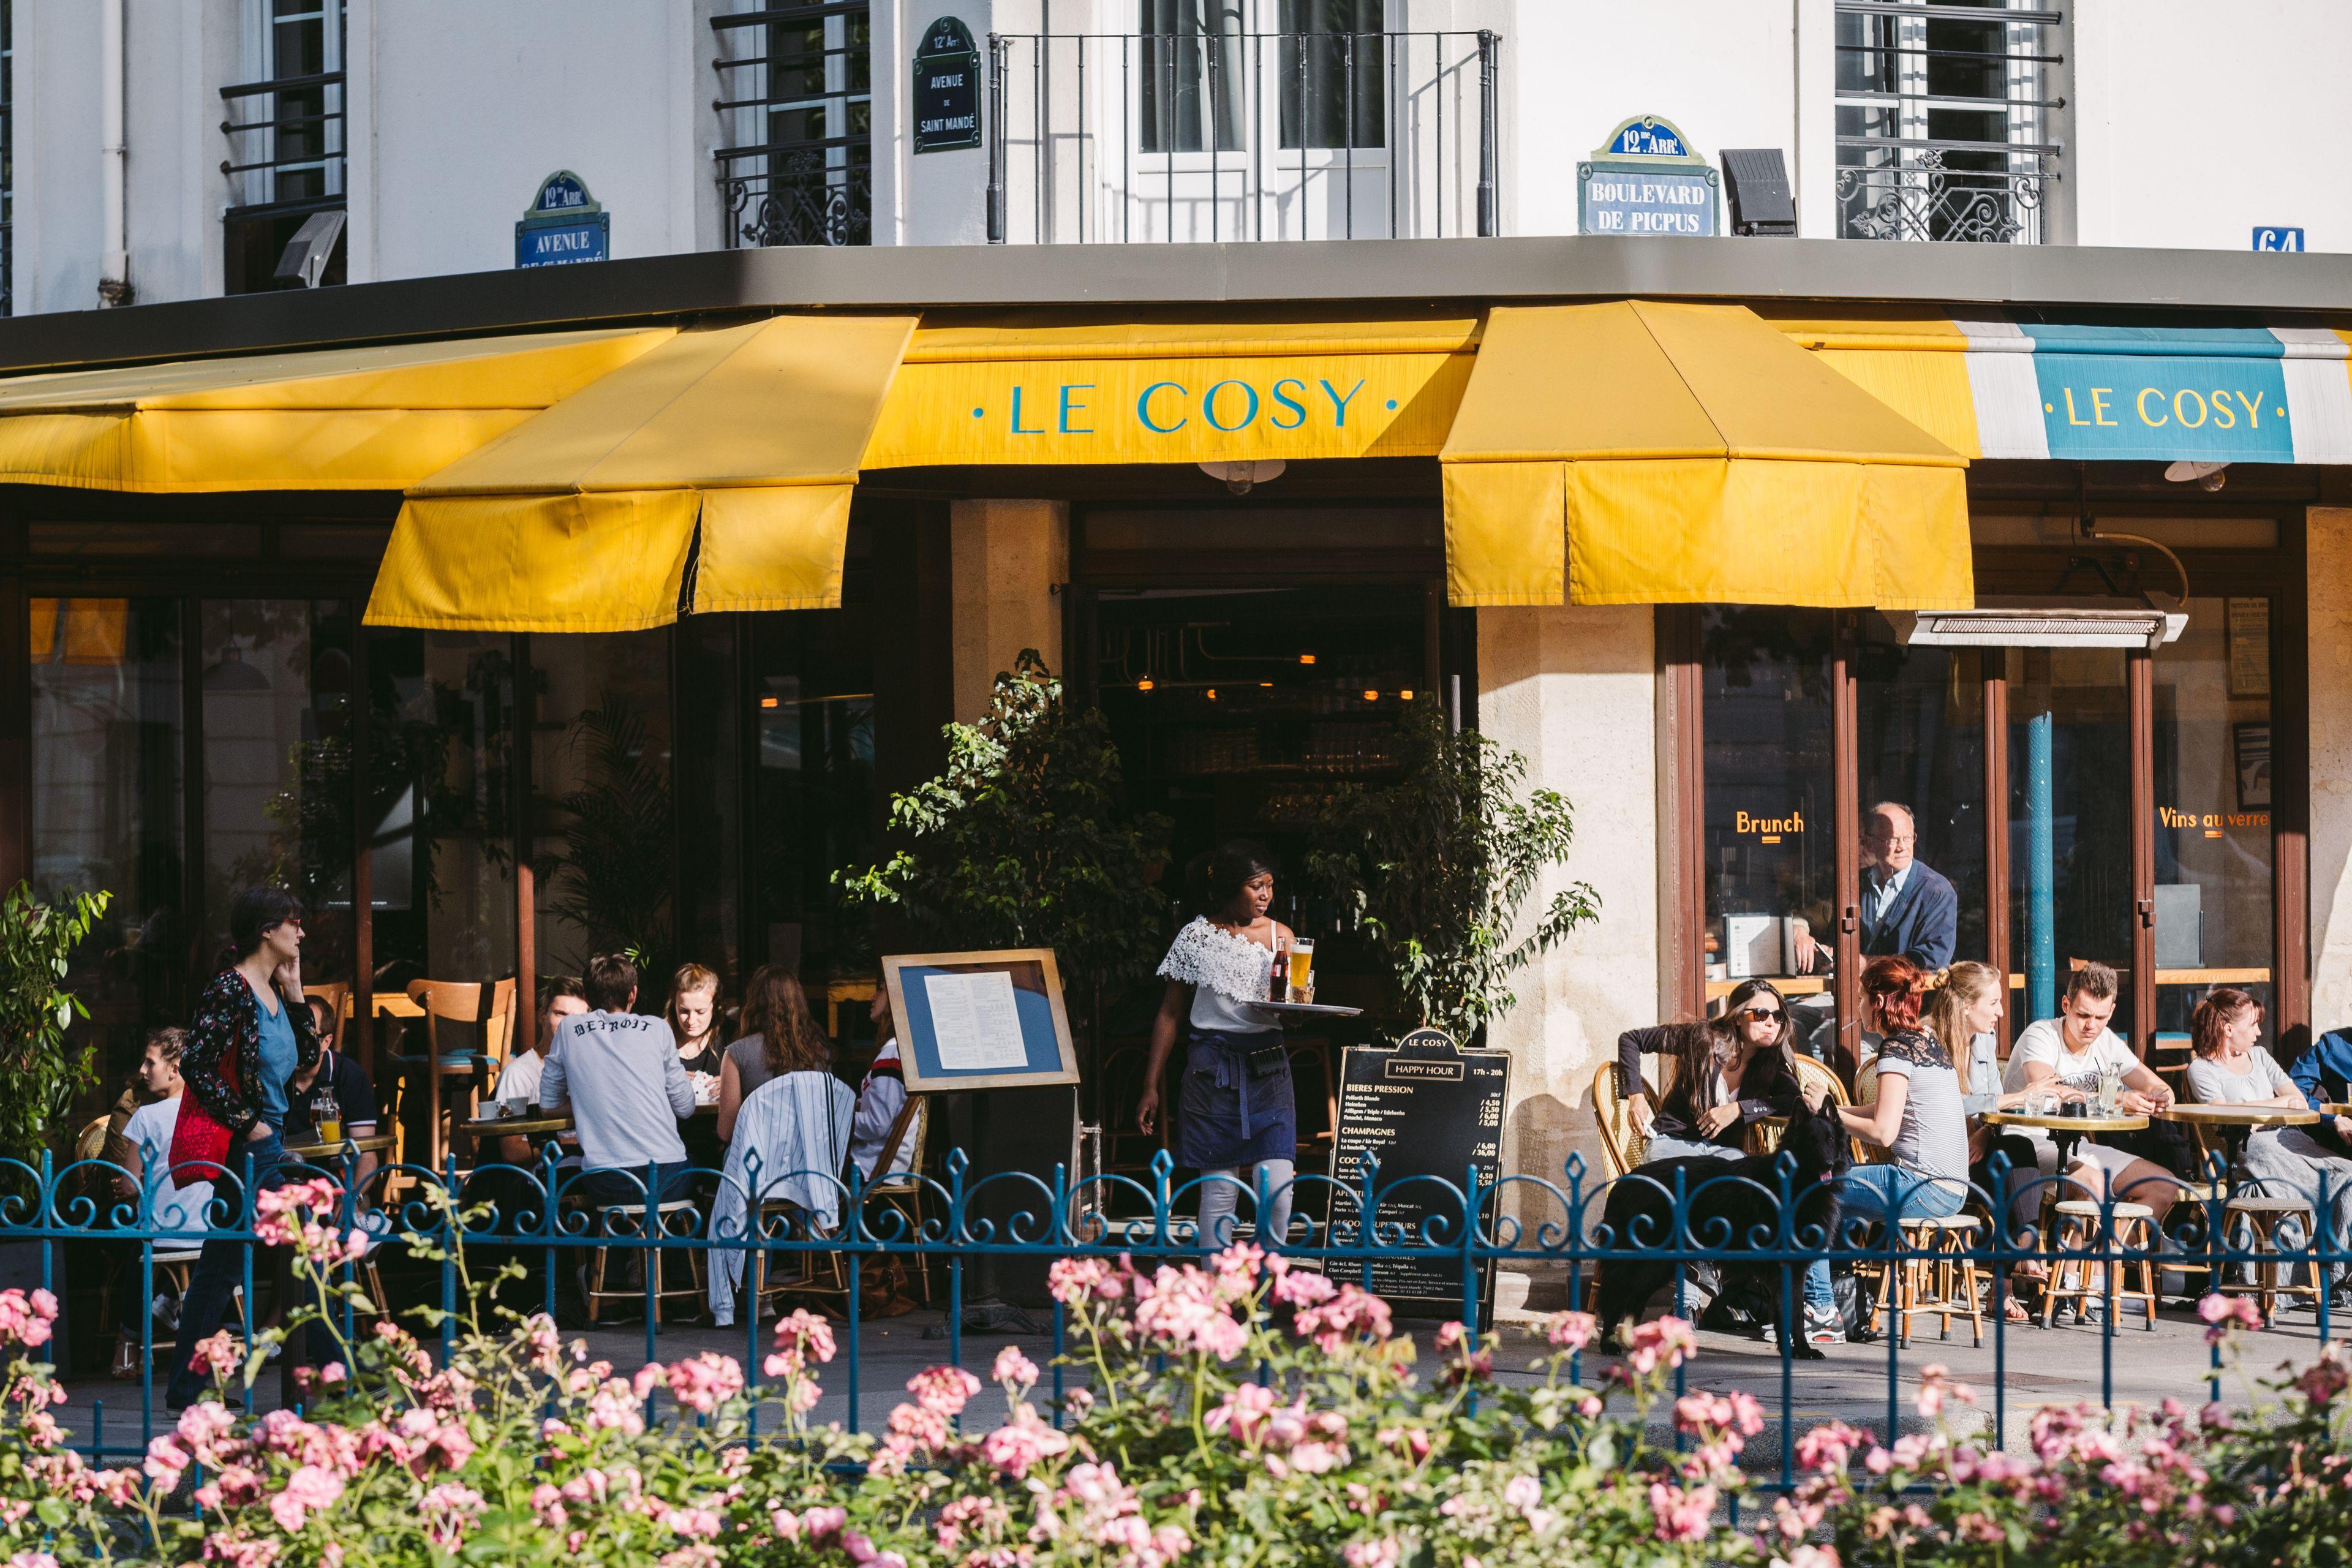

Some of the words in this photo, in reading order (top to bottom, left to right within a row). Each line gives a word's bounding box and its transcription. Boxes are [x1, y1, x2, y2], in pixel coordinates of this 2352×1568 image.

[930, 74, 963, 89] AVENUE
[921, 119, 944, 133] SAINT
[945, 113, 975, 130] MANDÉ
[1591, 183, 1706, 205] BOULEVARD
[1597, 210, 1624, 230] DE
[1630, 211, 1700, 233] PICPUS
[535, 231, 590, 254] AVENUE
[1011, 383, 1096, 434] LE
[1136, 378, 1366, 434] COSY
[2064, 387, 2119, 426] LE
[2136, 388, 2264, 429] COSY
[1736, 810, 1804, 834] Brunch
[2159, 806, 2198, 828] Vins
[2203, 814, 2223, 827] au
[2227, 813, 2269, 827] verre
[573, 1017, 652, 1037] DETROIT
[1408, 1038, 1419, 1047] LE
[1422, 1039, 1448, 1047] COSY
[1395, 1065, 1425, 1074] HAPPY
[1426, 1066, 1454, 1076] HOUR
[1346, 1084, 1373, 1093] BIERES
[1374, 1085, 1414, 1095] PRESSION
[1341, 1126, 1396, 1136] CHAMPAGNES
[1477, 1148, 1496, 1157] 36,00
